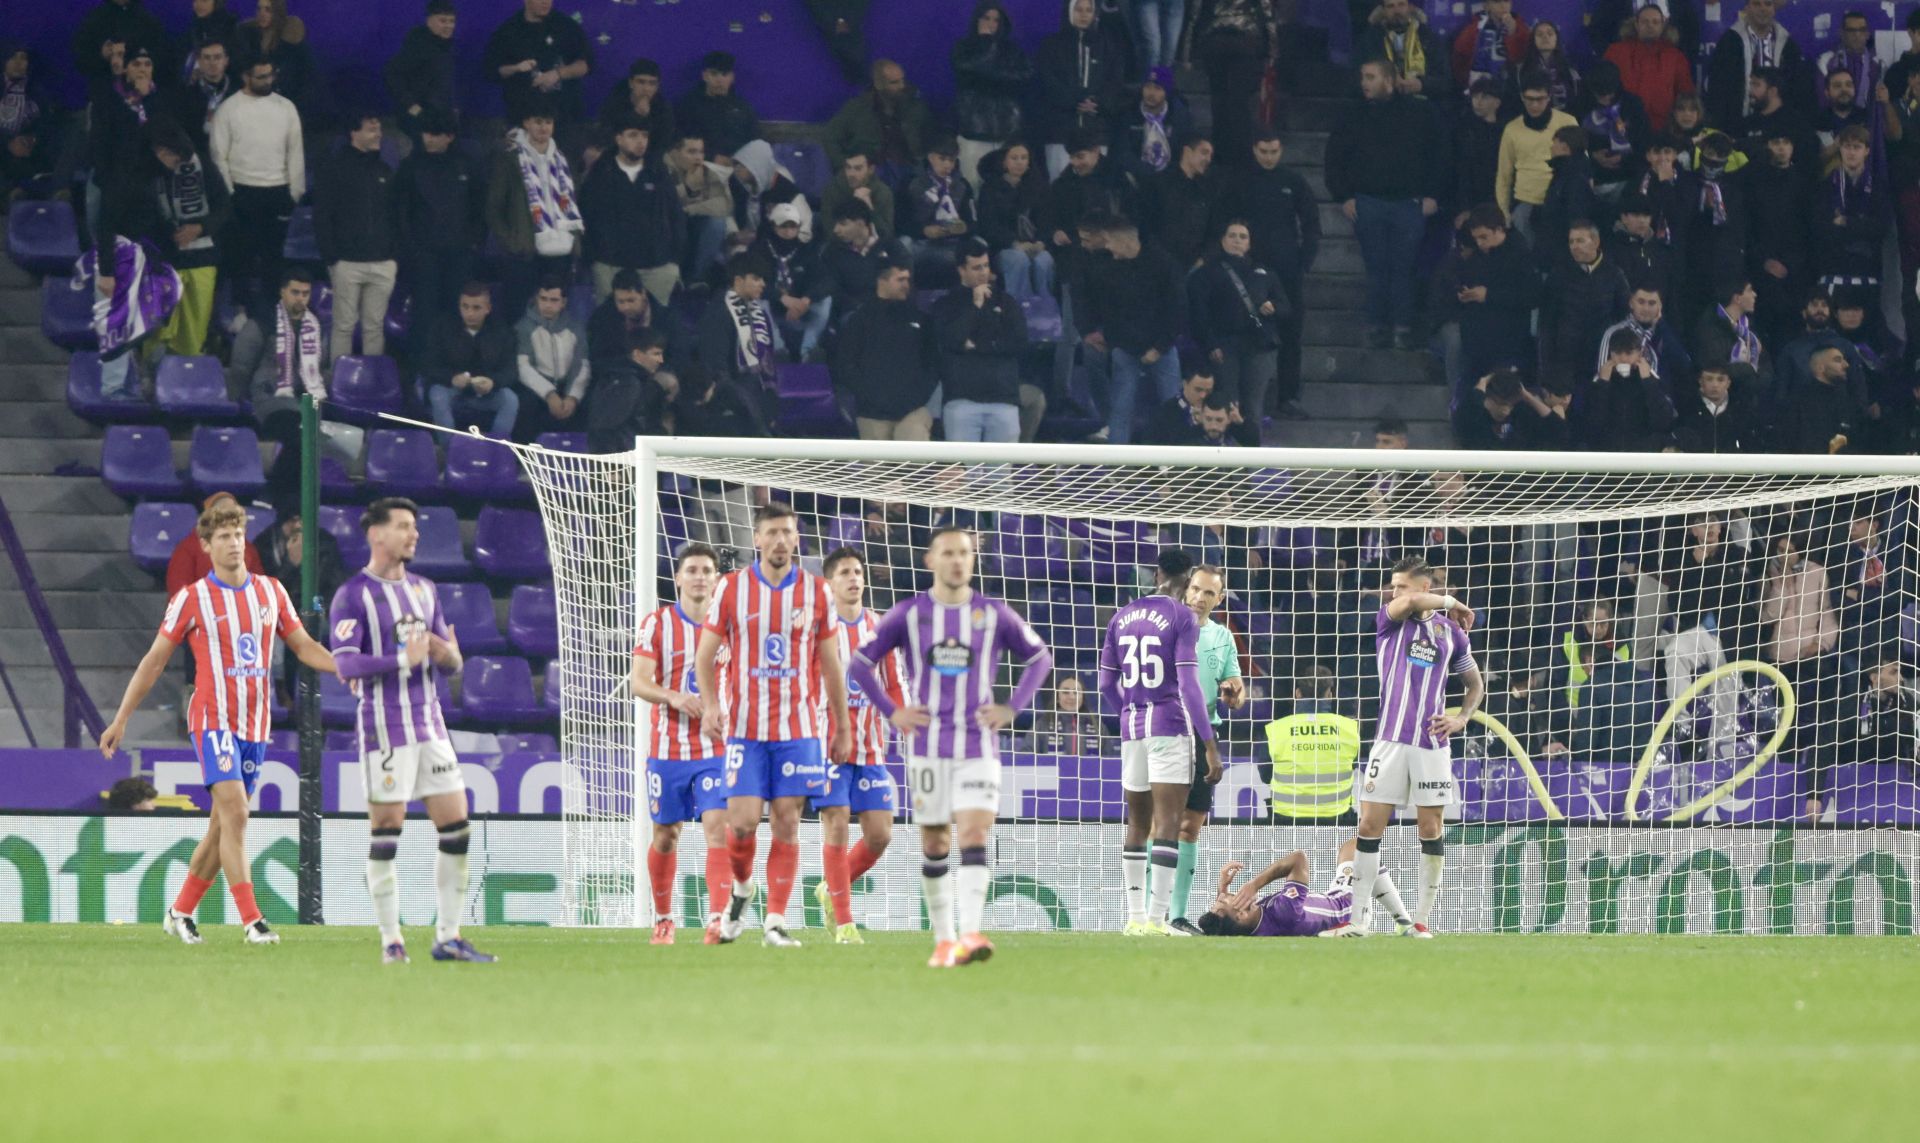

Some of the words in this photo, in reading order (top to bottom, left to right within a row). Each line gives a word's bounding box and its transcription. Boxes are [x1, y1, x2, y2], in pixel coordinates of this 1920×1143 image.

[1118, 609, 1146, 630] JUMA
[1147, 609, 1170, 632] BAH
[1118, 635, 1165, 689] 35
[207, 730, 235, 756] 14
[1290, 725, 1339, 737] EULEN
[725, 743, 746, 770] 15
[1291, 742, 1341, 752] SEGURIDAD
[381, 748, 394, 772] 2
[1369, 758, 1381, 779] 5
[647, 770, 663, 798] 19
[911, 767, 936, 794] 10
